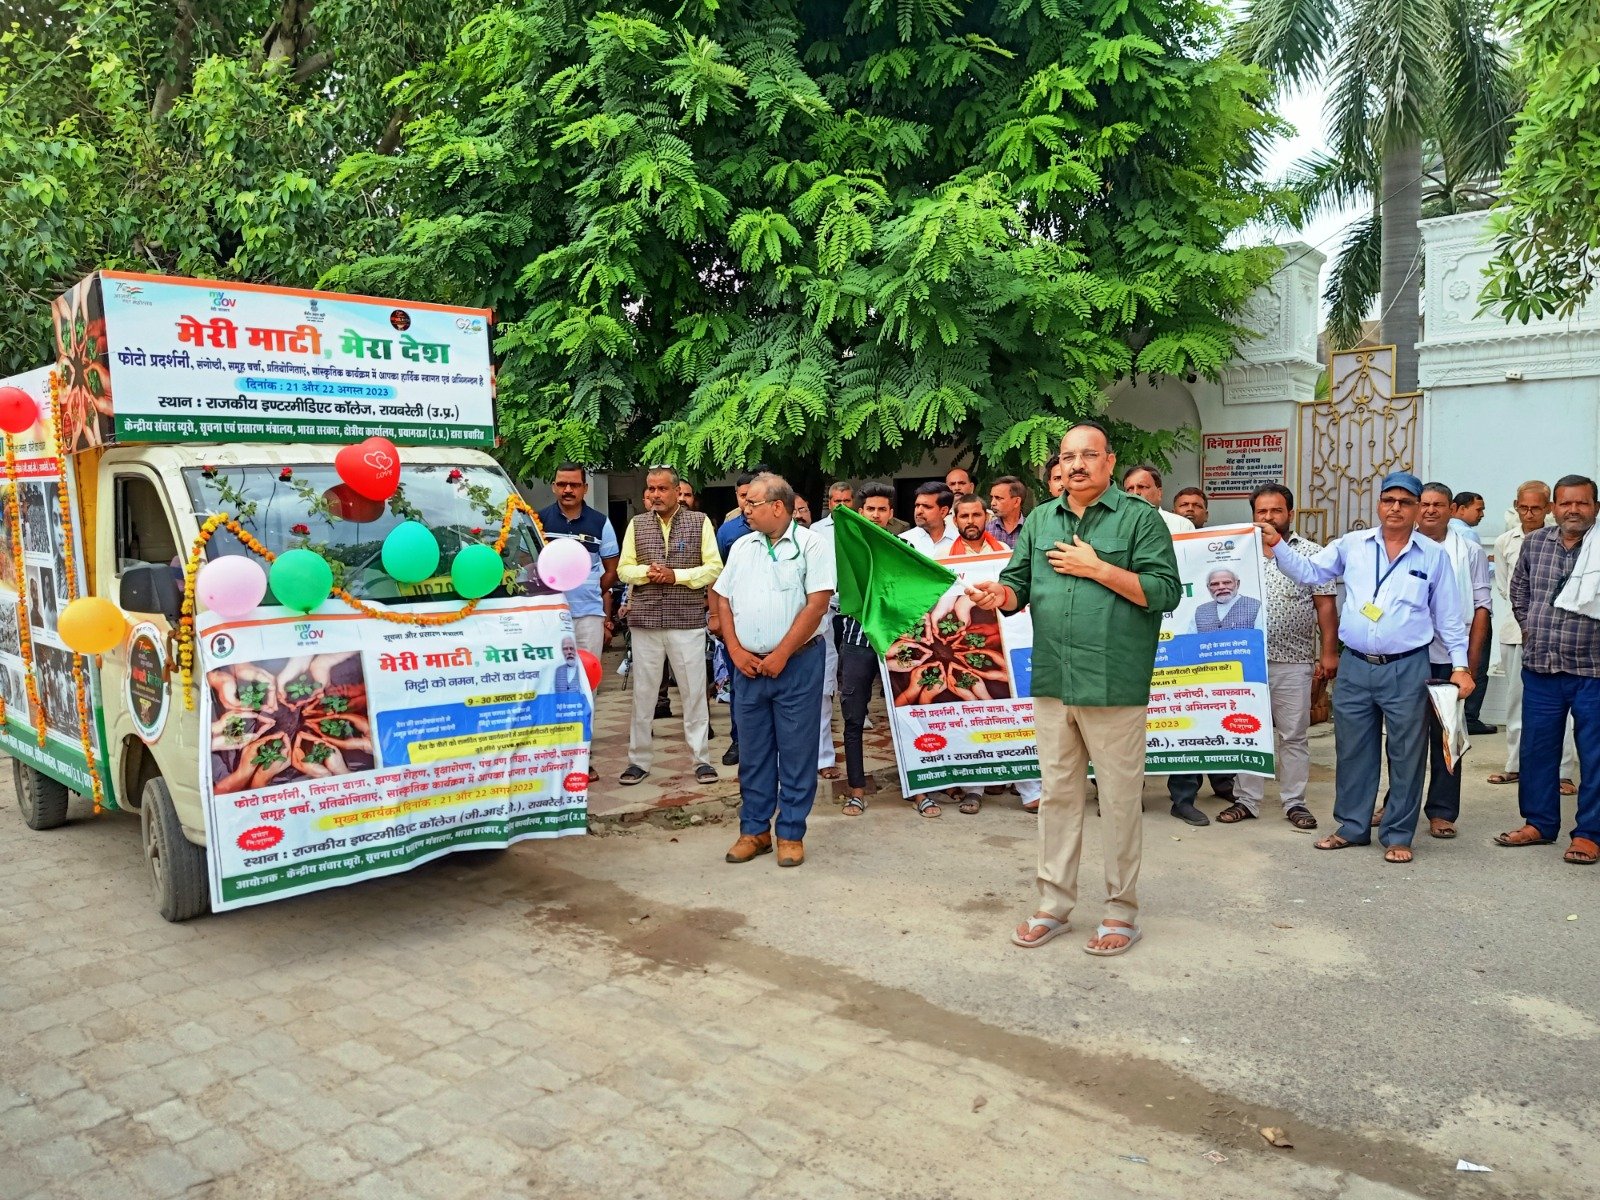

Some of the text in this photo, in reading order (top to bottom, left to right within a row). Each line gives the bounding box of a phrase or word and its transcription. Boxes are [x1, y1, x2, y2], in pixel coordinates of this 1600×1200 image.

[213, 298, 237, 307] GOV
[175, 314, 239, 349] मेरी
[338, 328, 393, 361] मेरा
[399, 333, 451, 364] देश
[118, 346, 147, 367] फोटो
[150, 350, 195, 371] प्रदर्शनी,
[228, 362, 246, 374] समूह
[345, 368, 370, 379] कार्यक्रम
[379, 371, 399, 380] आपका
[246, 378, 389, 396] दिनांक 21 और 22 अगस्त 2023
[158, 396, 193, 409] स्थान
[206, 394, 257, 411] राजकीय
[427, 403, 460, 421] (उ.प्र.)
[124, 417, 153, 433] केन्द्रीय
[154, 419, 176, 433] संचार
[199, 421, 222, 437] सूचना
[1206, 434, 1283, 450] दिनेश प्रताप सिंह
[294, 623, 311, 632] my
[300, 630, 324, 640] GOV
[1160, 632, 1171, 640] 23
[378, 651, 418, 672] मेरी
[483, 645, 518, 663] मेरा
[522, 643, 554, 661] देश
[404, 679, 429, 694] मिट्टी
[431, 674, 447, 688] को
[502, 671, 517, 682] का
[467, 698, 474, 706] 9
[480, 696, 491, 704] 30
[909, 708, 927, 719] फोटो
[982, 733, 1002, 743] मुख्य
[1153, 720, 1180, 729] 2023
[920, 753, 945, 764] स्थान
[954, 749, 994, 761] राजकीय
[916, 769, 947, 782] आयोजक
[234, 794, 259, 809] फोटो
[262, 787, 306, 806] प्रदर्शनी,
[308, 781, 339, 797] तिरंगा
[260, 810, 286, 822] समूह
[431, 776, 466, 791] कार्यक्रम
[477, 770, 505, 783] आपका
[332, 815, 359, 828] मुख्य
[402, 794, 432, 812] दिनांक
[440, 795, 452, 805] 21
[454, 789, 472, 802] और
[476, 790, 486, 799] 22
[512, 782, 534, 793] 2023
[242, 852, 279, 868] स्थान
[292, 837, 346, 858] राजकीय
[235, 873, 279, 890] आयोजक
[286, 863, 317, 879] केन्द्रीय
[318, 859, 342, 872] संचार
